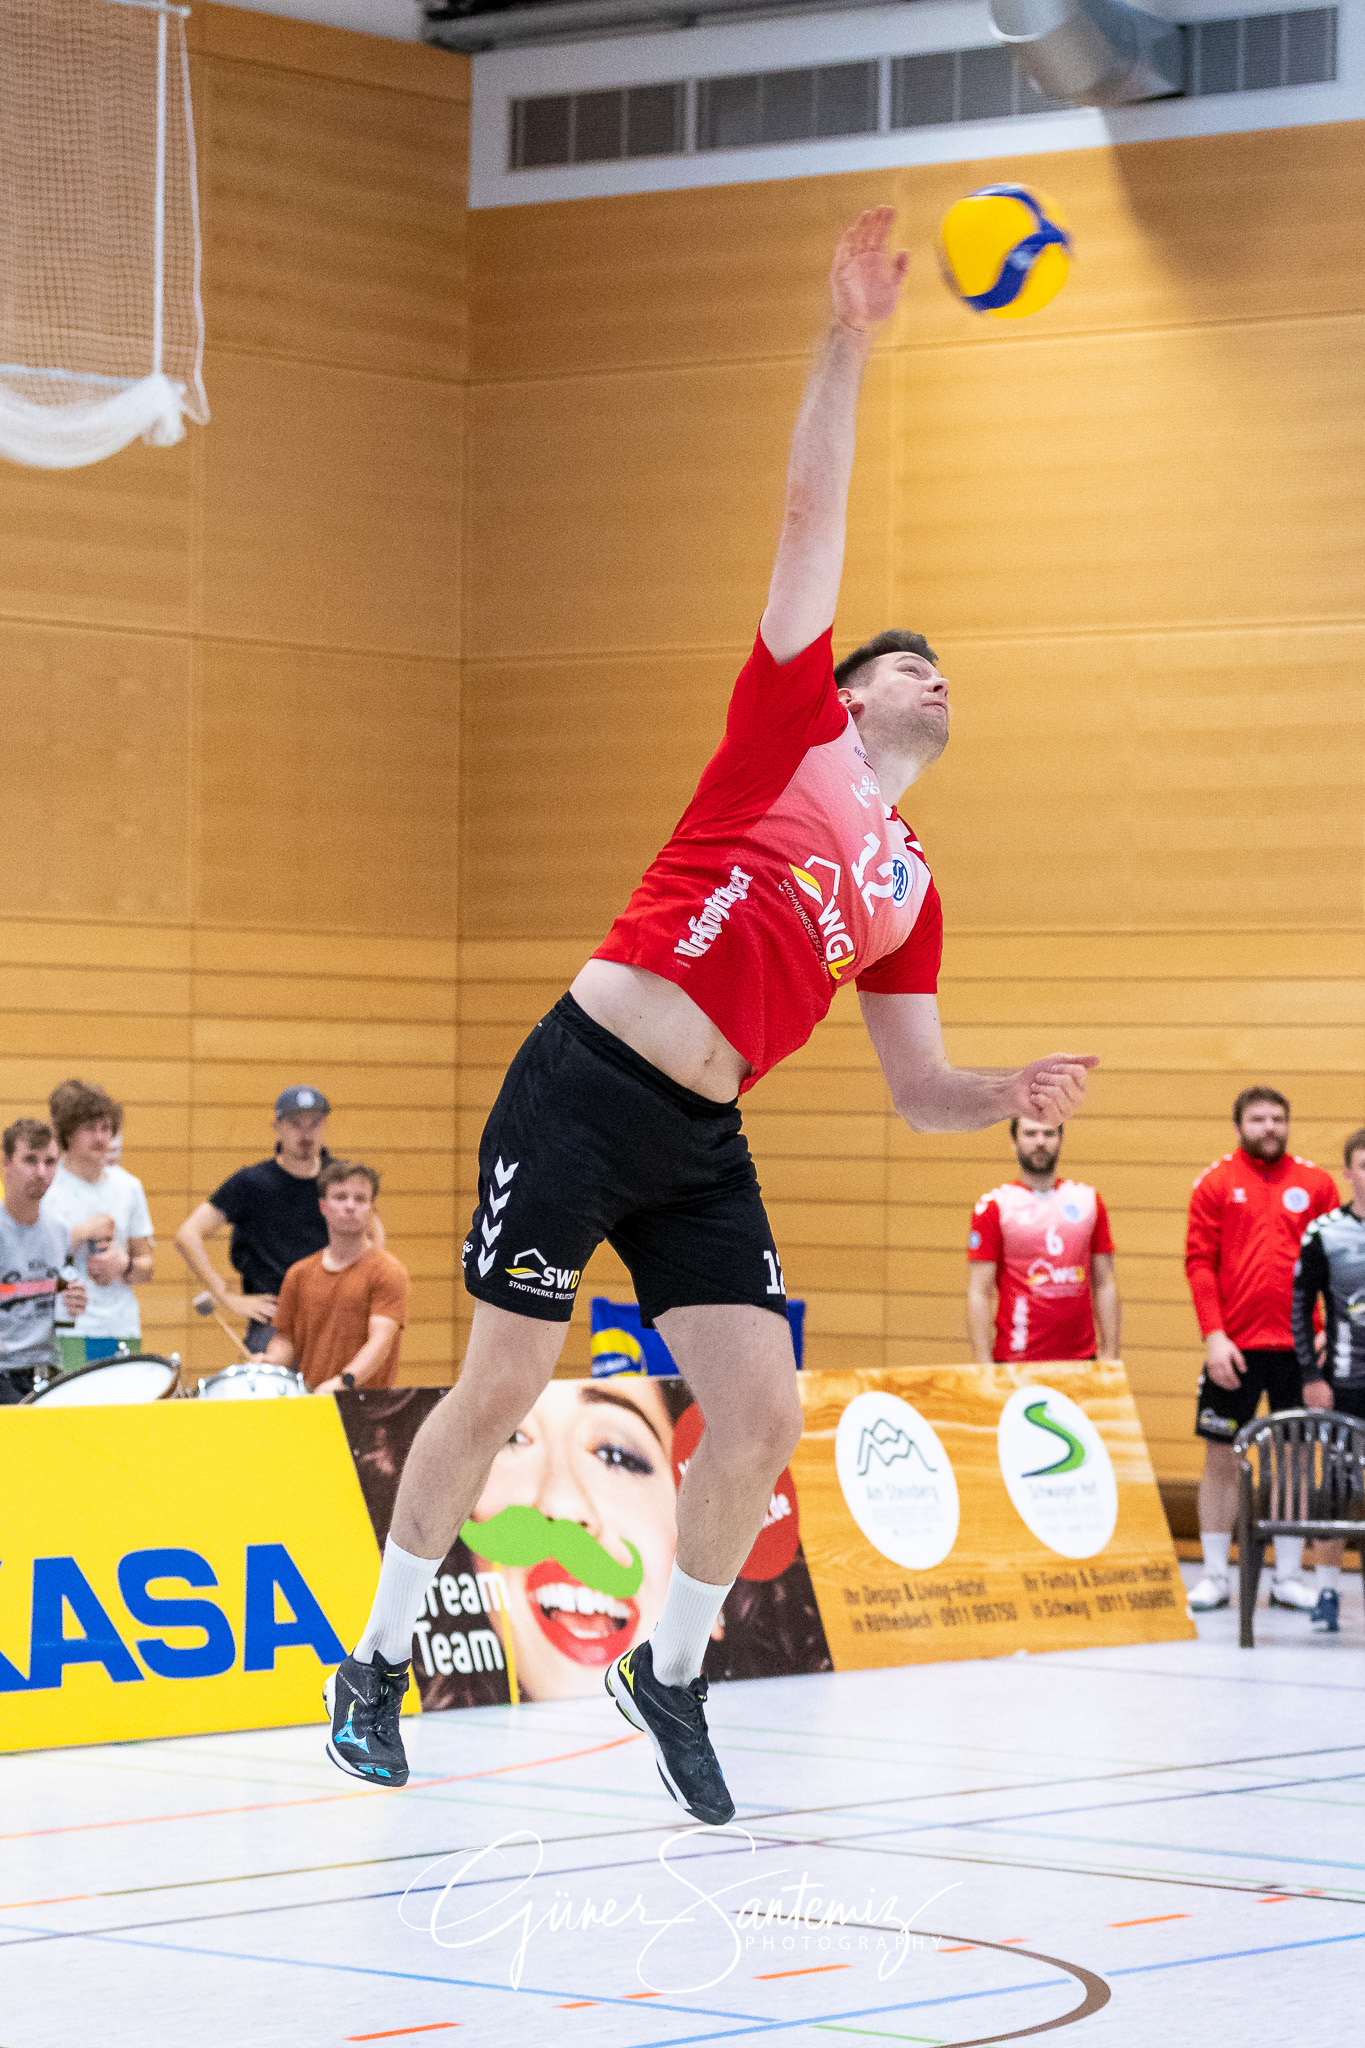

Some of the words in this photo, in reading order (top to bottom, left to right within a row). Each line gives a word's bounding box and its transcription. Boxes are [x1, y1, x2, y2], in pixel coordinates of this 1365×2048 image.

[817, 895, 856, 980] WGL
[1045, 1225, 1065, 1256] 6
[508, 1280, 554, 1299] STADTWERKE
[540, 1266, 580, 1289] SWD
[412, 1619, 506, 1677] Team
